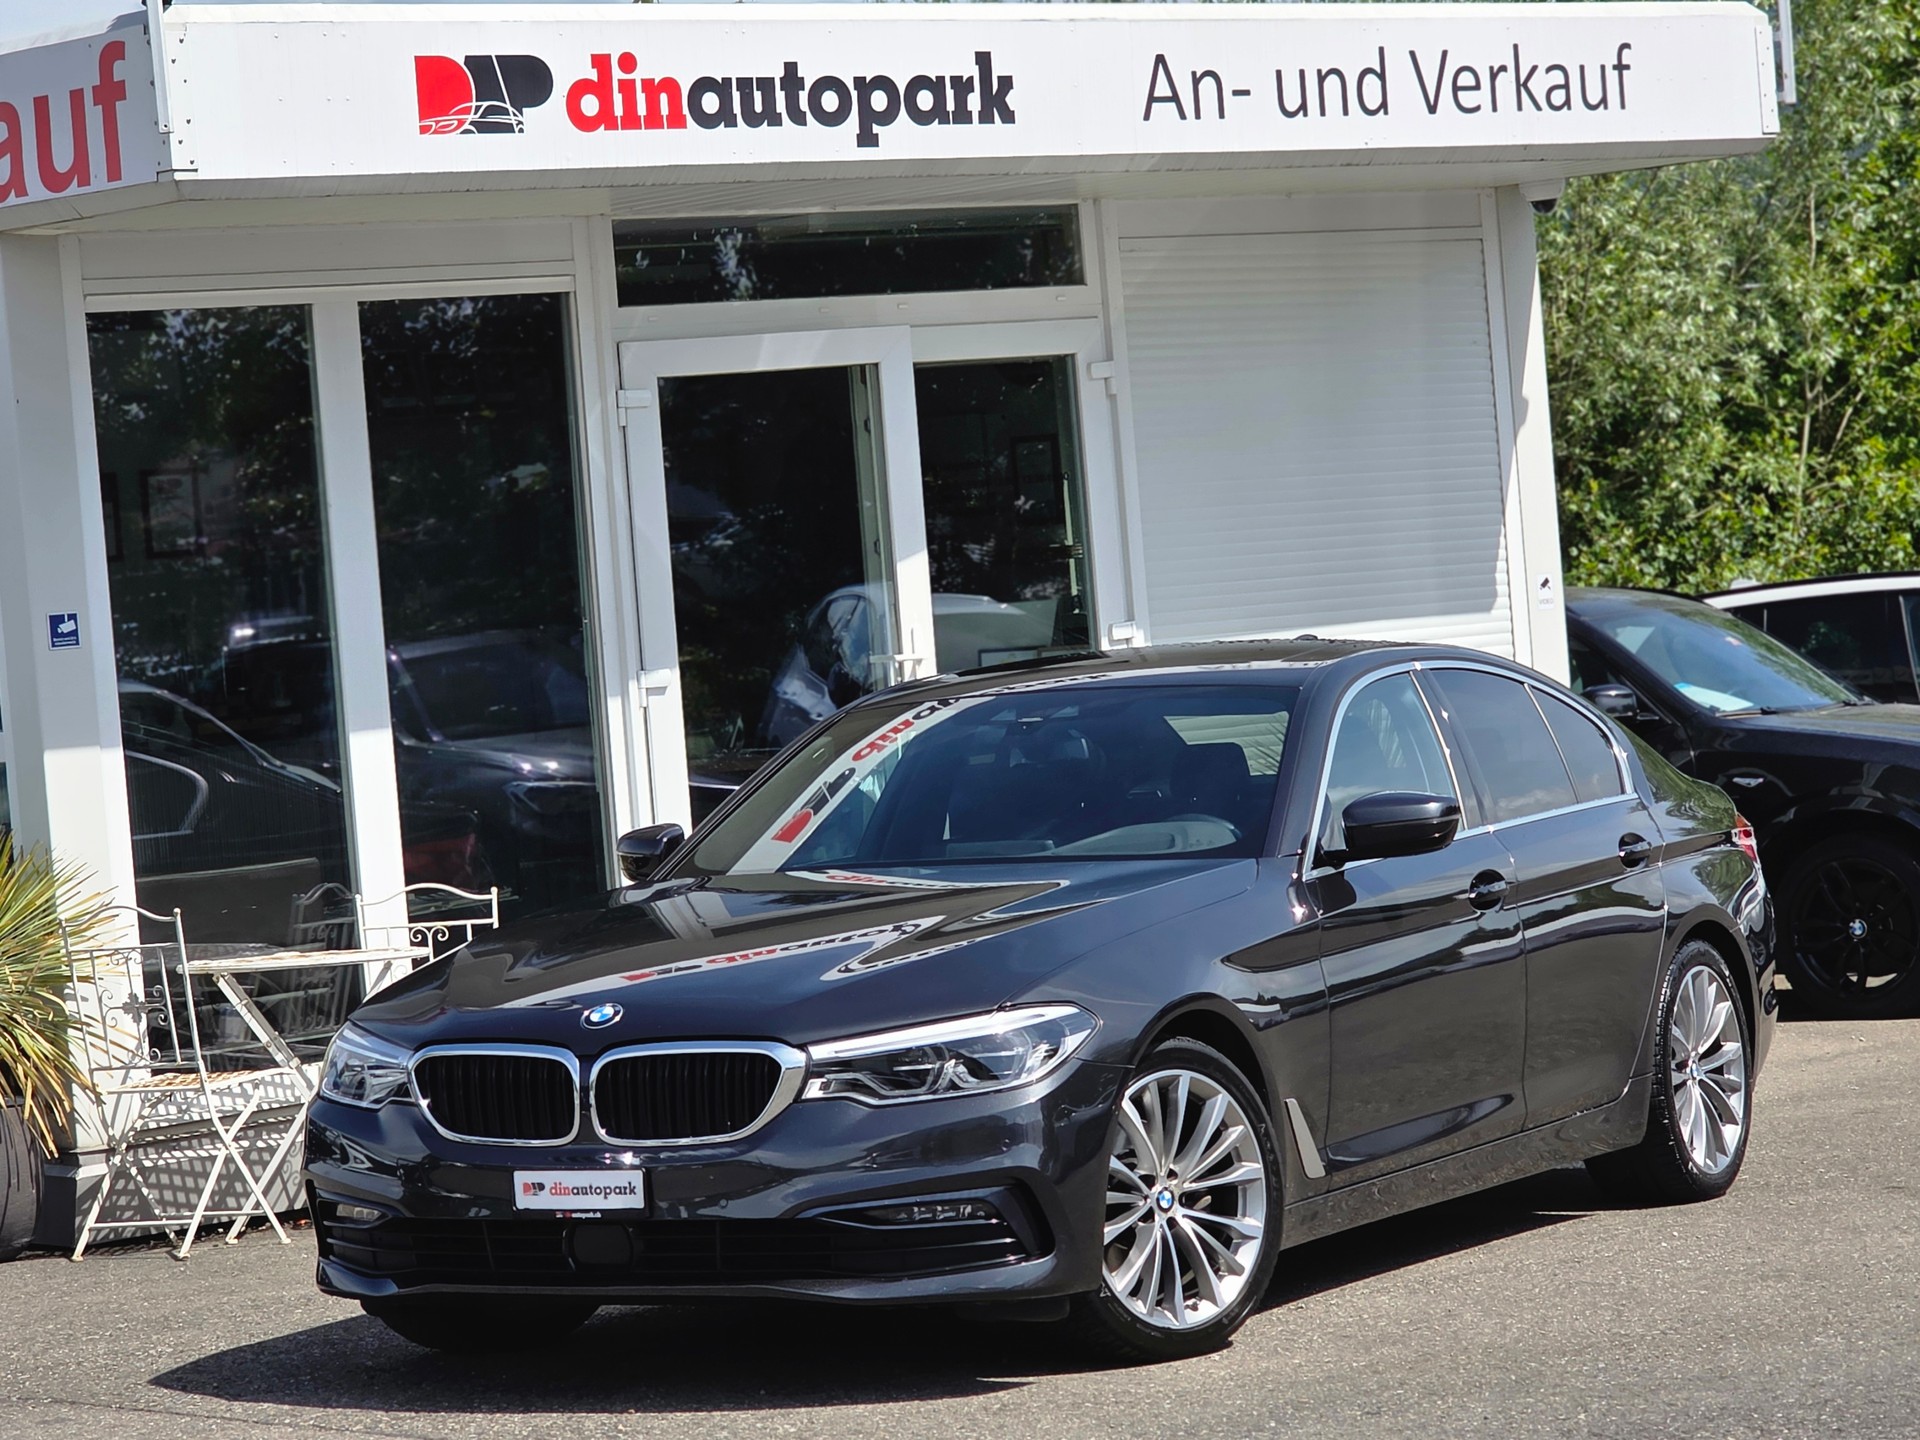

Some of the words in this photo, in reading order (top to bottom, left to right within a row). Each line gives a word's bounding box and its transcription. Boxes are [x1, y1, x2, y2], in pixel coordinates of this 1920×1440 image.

[565, 51, 1016, 148] dinautopark
[1143, 53, 1251, 122] An-
[1275, 46, 1389, 119] und
[1408, 42, 1632, 116] Verkauf
[549, 1181, 637, 1200] dinautopark
